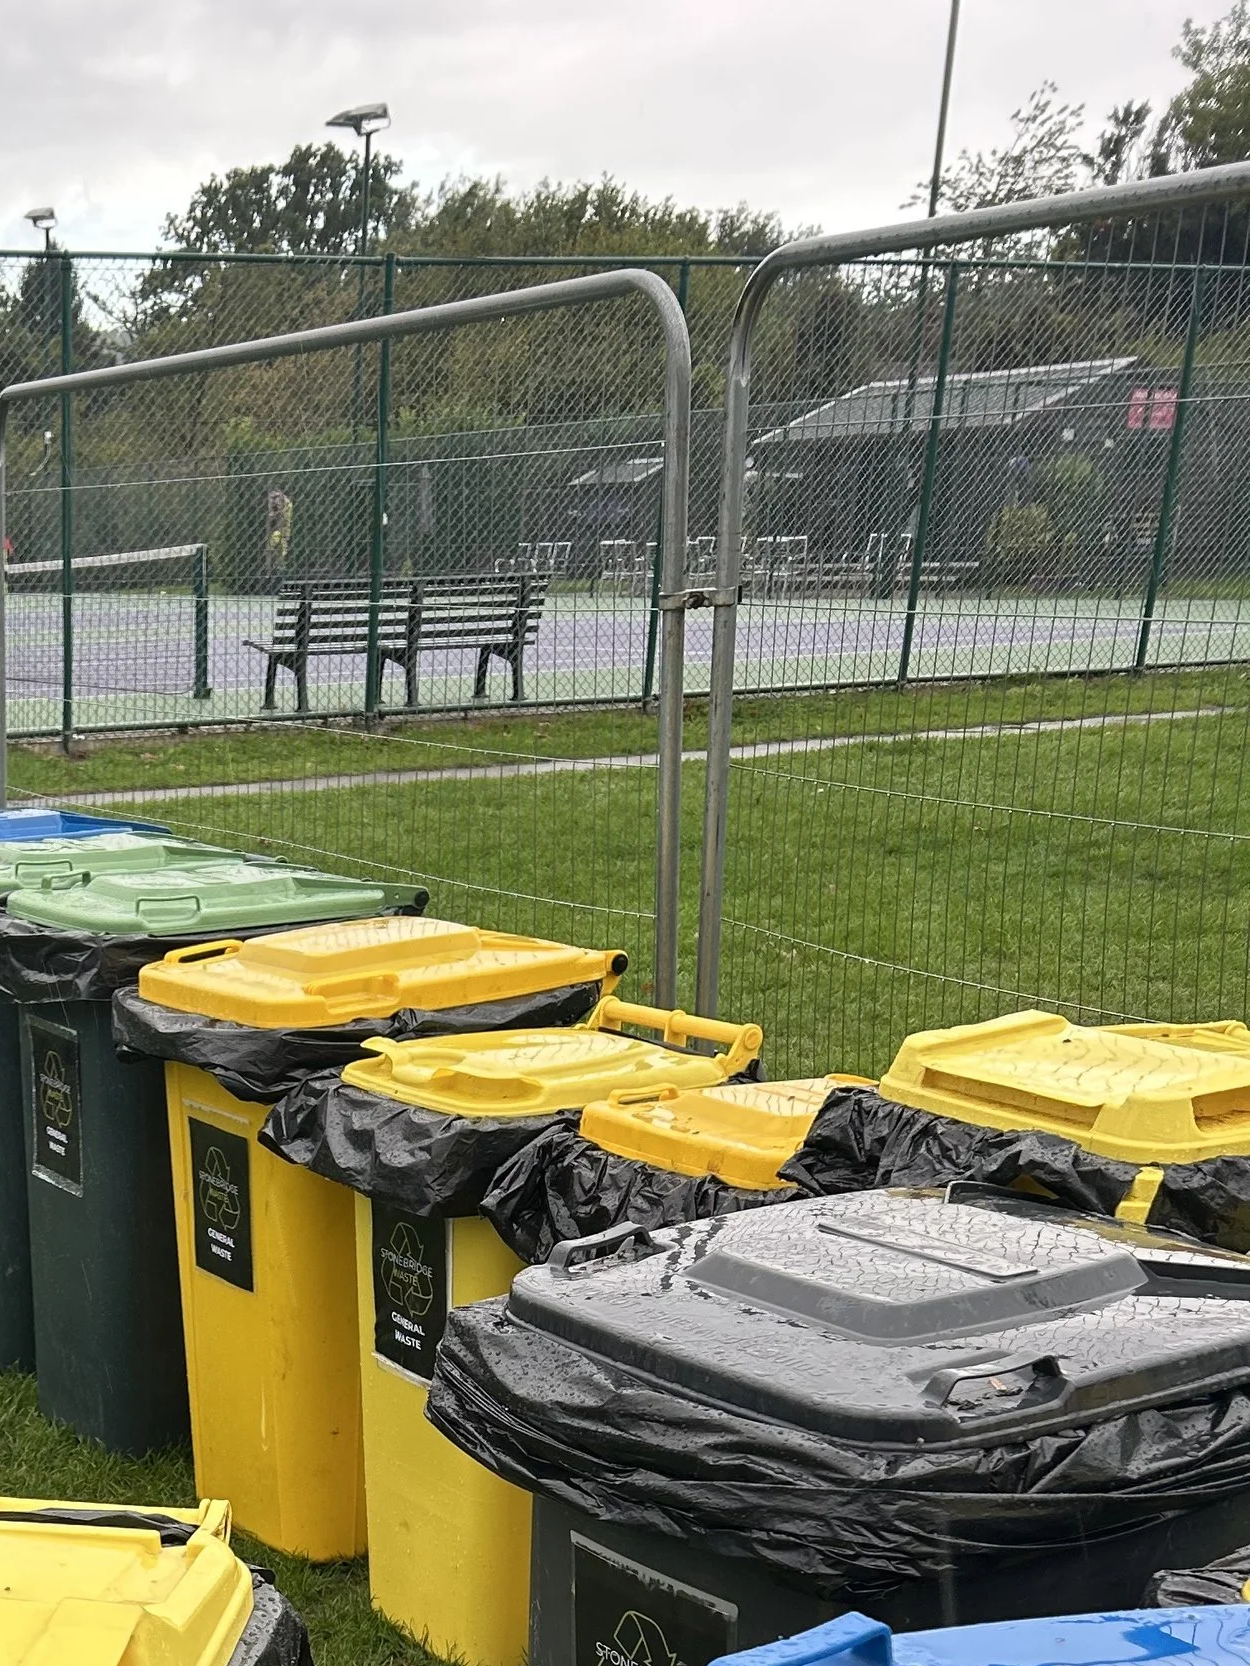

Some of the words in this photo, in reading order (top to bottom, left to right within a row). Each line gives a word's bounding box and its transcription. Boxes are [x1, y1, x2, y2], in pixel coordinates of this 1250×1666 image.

[207, 1227, 235, 1248] GENERAL
[210, 1243, 232, 1262] WASTE
[380, 1247, 433, 1278] STONEBRIDGE
[392, 1268, 419, 1287] WASTE
[391, 1311, 425, 1336] GENERAL
[394, 1329, 422, 1350] WASTE
